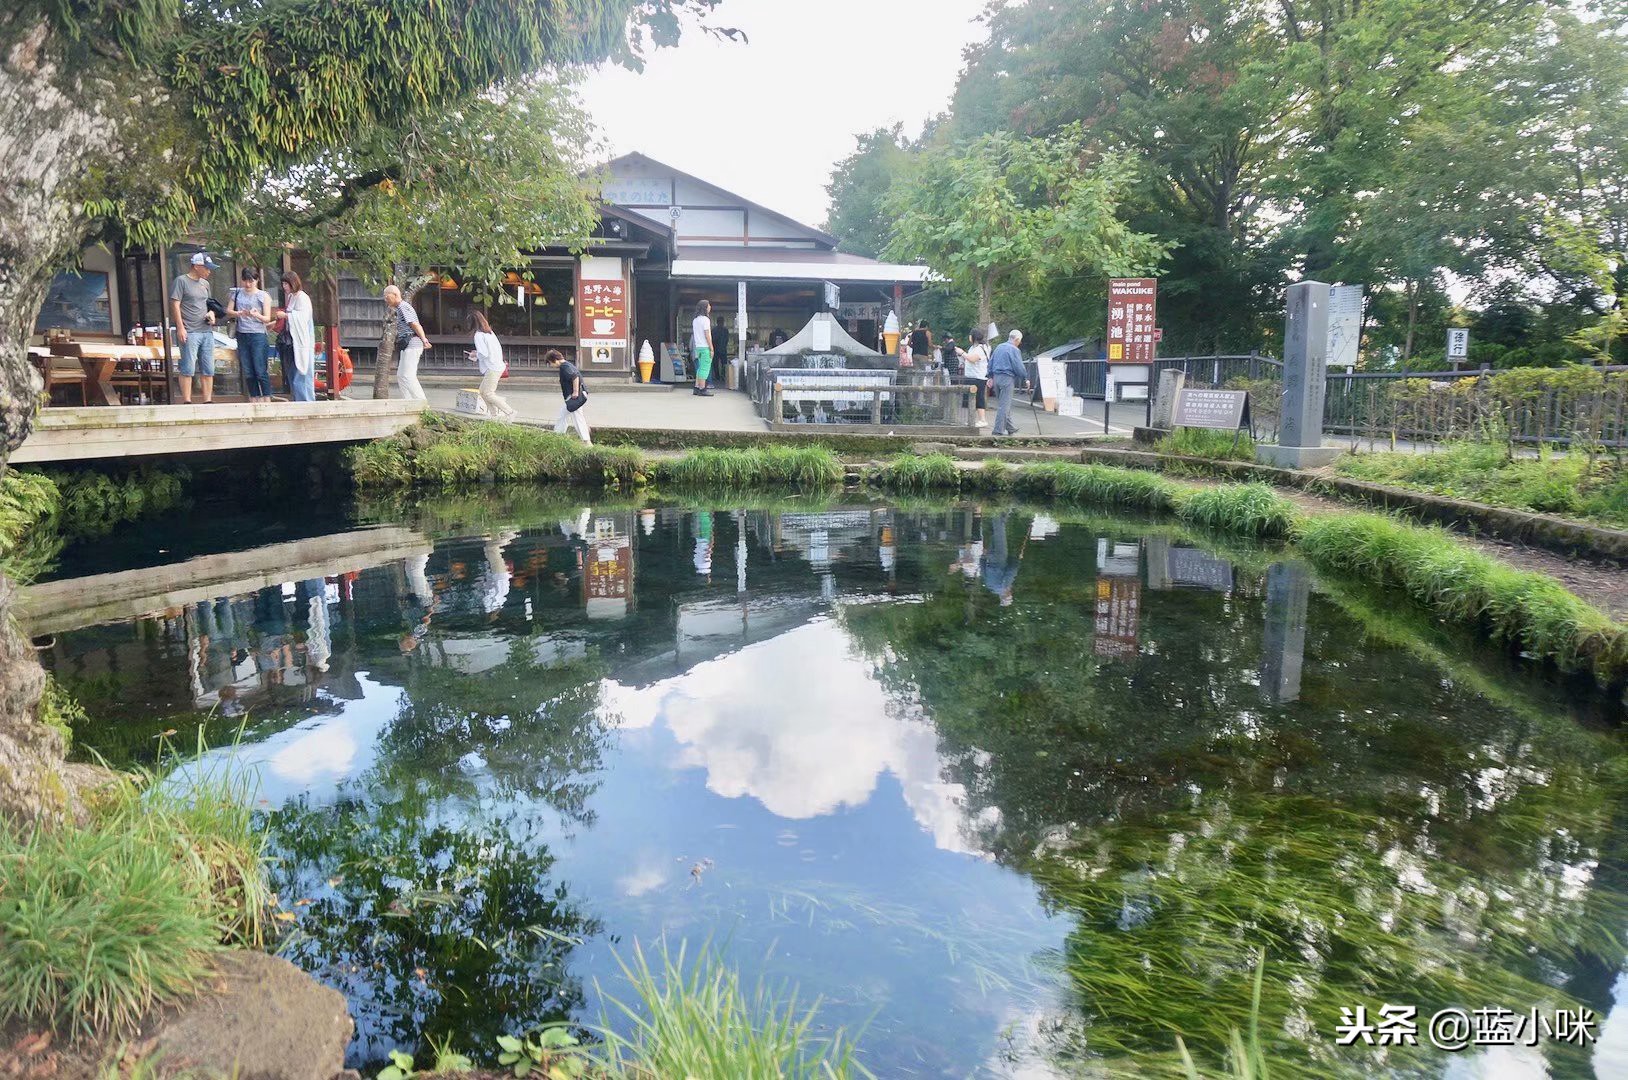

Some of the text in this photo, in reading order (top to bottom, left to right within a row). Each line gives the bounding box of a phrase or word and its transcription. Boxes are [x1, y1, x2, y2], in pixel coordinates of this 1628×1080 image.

[585, 306, 622, 317] コーヒー
[1134, 303, 1143, 342] 世界遺産
[1143, 303, 1152, 342] 名水百選
[1454, 332, 1464, 355] 徐行
